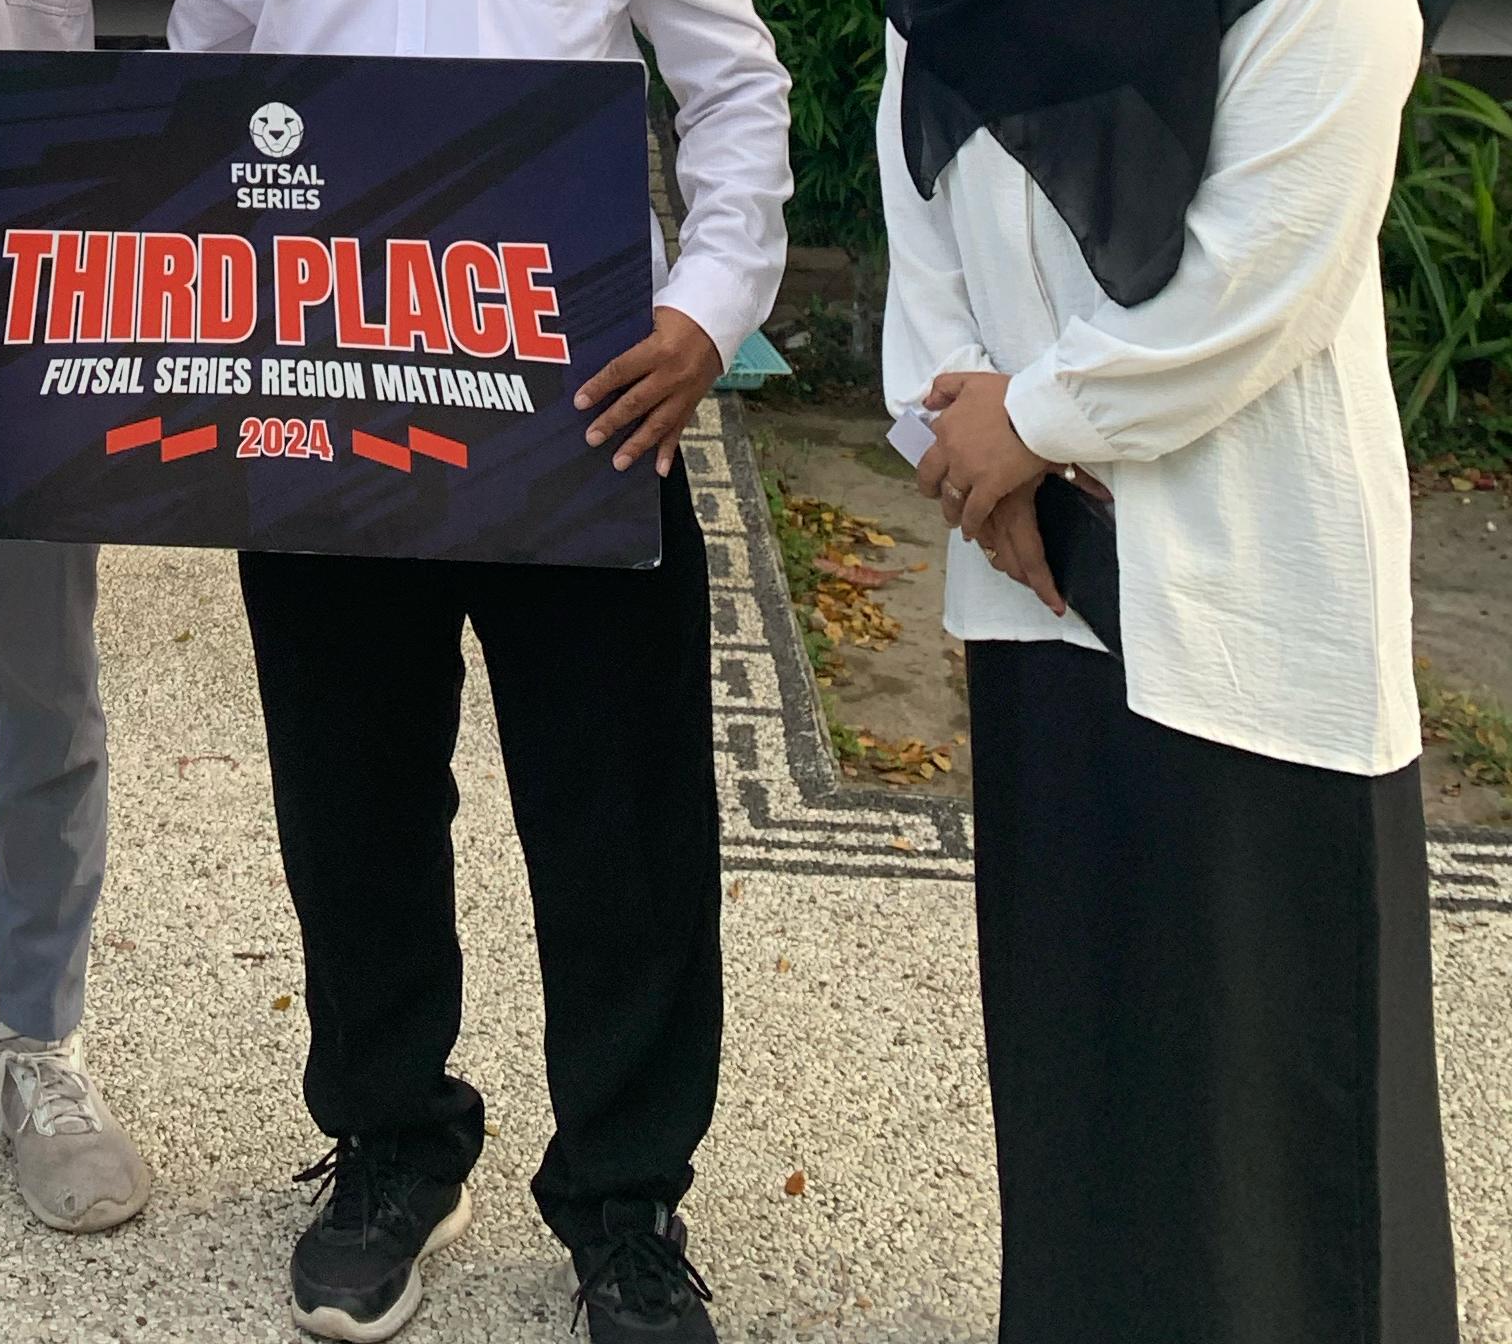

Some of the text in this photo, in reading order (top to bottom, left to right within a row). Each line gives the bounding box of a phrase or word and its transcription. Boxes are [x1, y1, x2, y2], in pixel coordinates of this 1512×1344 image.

[230, 163, 326, 186] FUTSAL
[236, 186, 321, 211] SERIES
[2, 229, 571, 365] THIRD PLACE
[39, 356, 535, 413] FUTSAL SERIES REGION MATARAM
[235, 416, 334, 462] 2024
